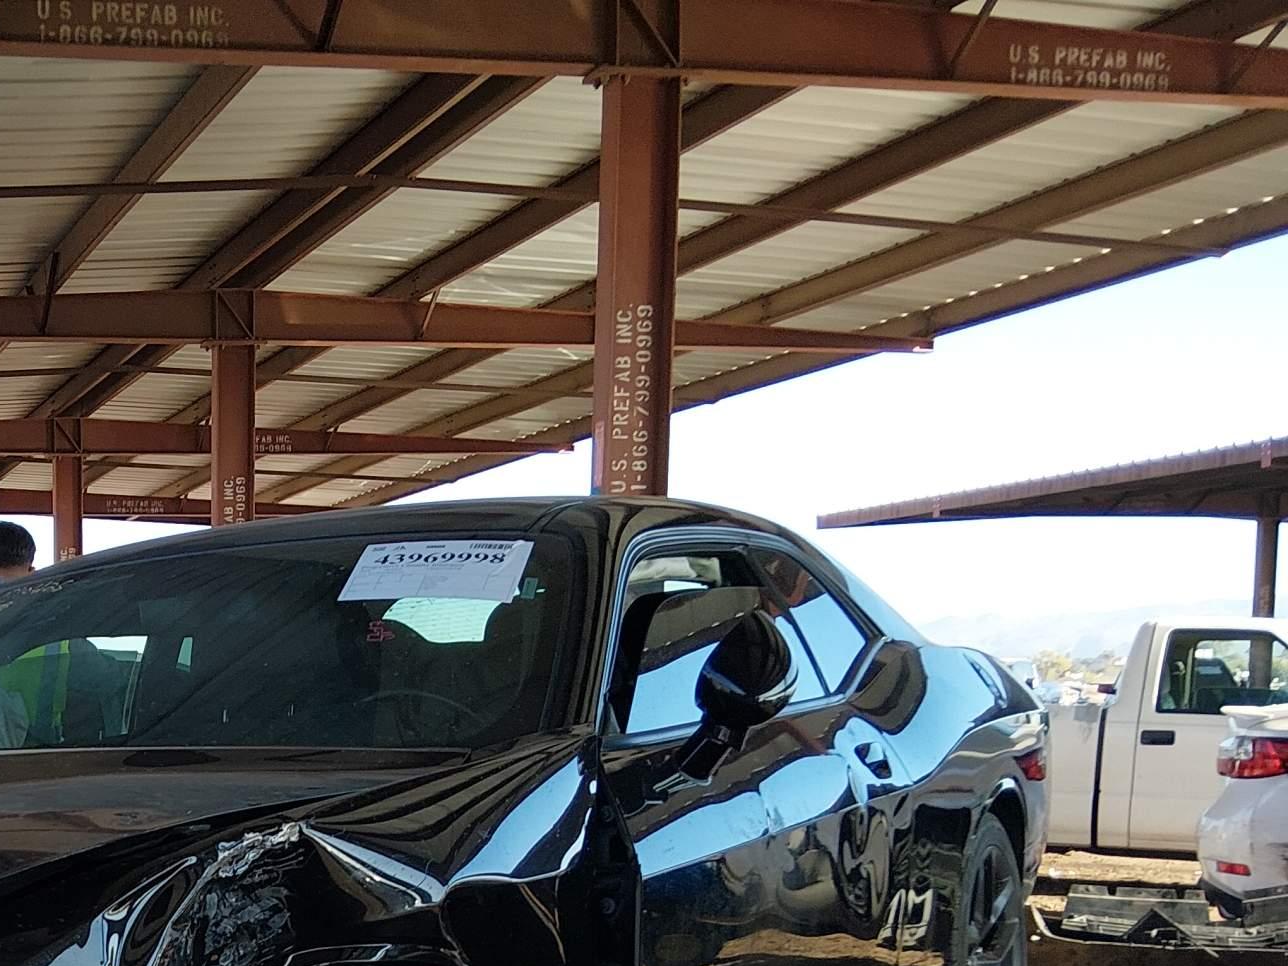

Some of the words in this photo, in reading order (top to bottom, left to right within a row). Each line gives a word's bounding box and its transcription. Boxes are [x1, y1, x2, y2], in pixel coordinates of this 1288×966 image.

[91, 1, 178, 26] PREFAB
[189, 6, 230, 28] INC.
[1054, 47, 1128, 69] PREFAB
[615, 302, 634, 344] INC.
[612, 355, 632, 440] PREFAB
[630, 304, 654, 491] 1-866-799-0969
[223, 475, 235, 500] INC.
[611, 451, 629, 494] U.S.
[374, 551, 507, 566] 43969998
